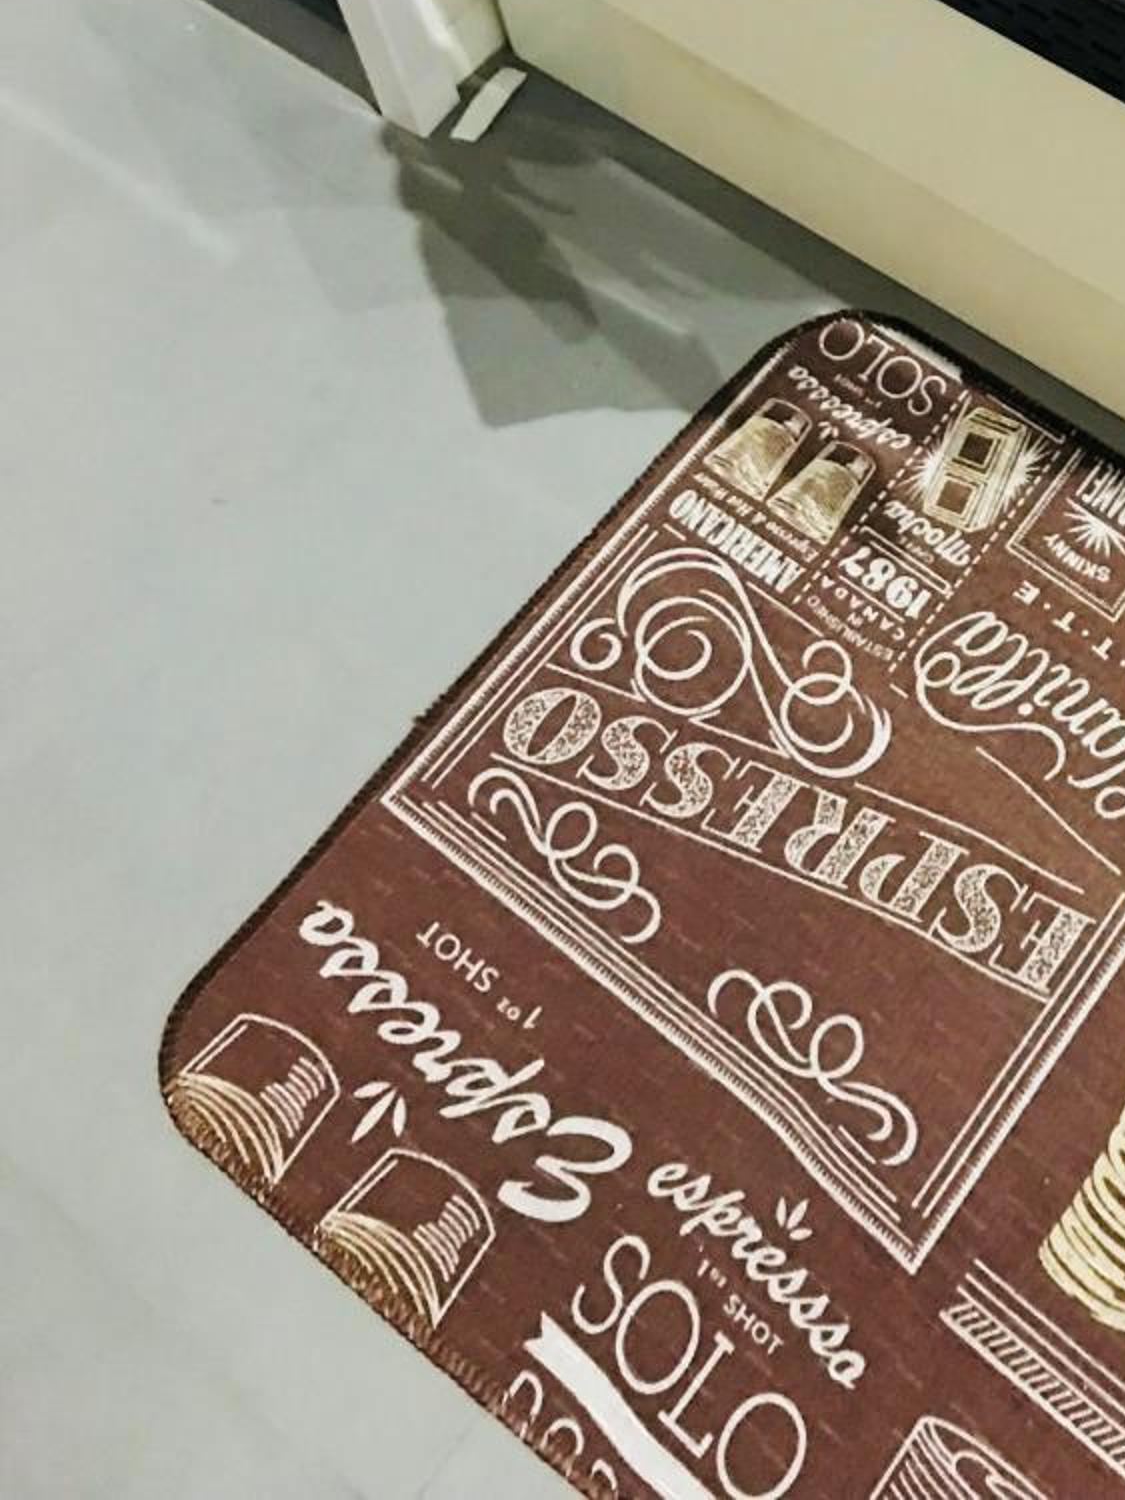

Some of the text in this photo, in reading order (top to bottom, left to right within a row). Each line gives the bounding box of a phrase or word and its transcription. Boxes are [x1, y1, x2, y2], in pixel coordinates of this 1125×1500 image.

[819, 318, 947, 415] SOLO
[669, 489, 806, 594] AMERICANO
[883, 500, 973, 567] Mocha
[1043, 533, 1111, 583] SKINNY
[820, 574, 905, 641] CANADA
[838, 546, 933, 620] 1987
[503, 687, 1098, 993] ESPRESSO
[414, 920, 501, 994] SHOT
[299, 900, 633, 1222] Espresso
[722, 1293, 785, 1355] SHOT
[571, 1235, 808, 1500] SOLO
